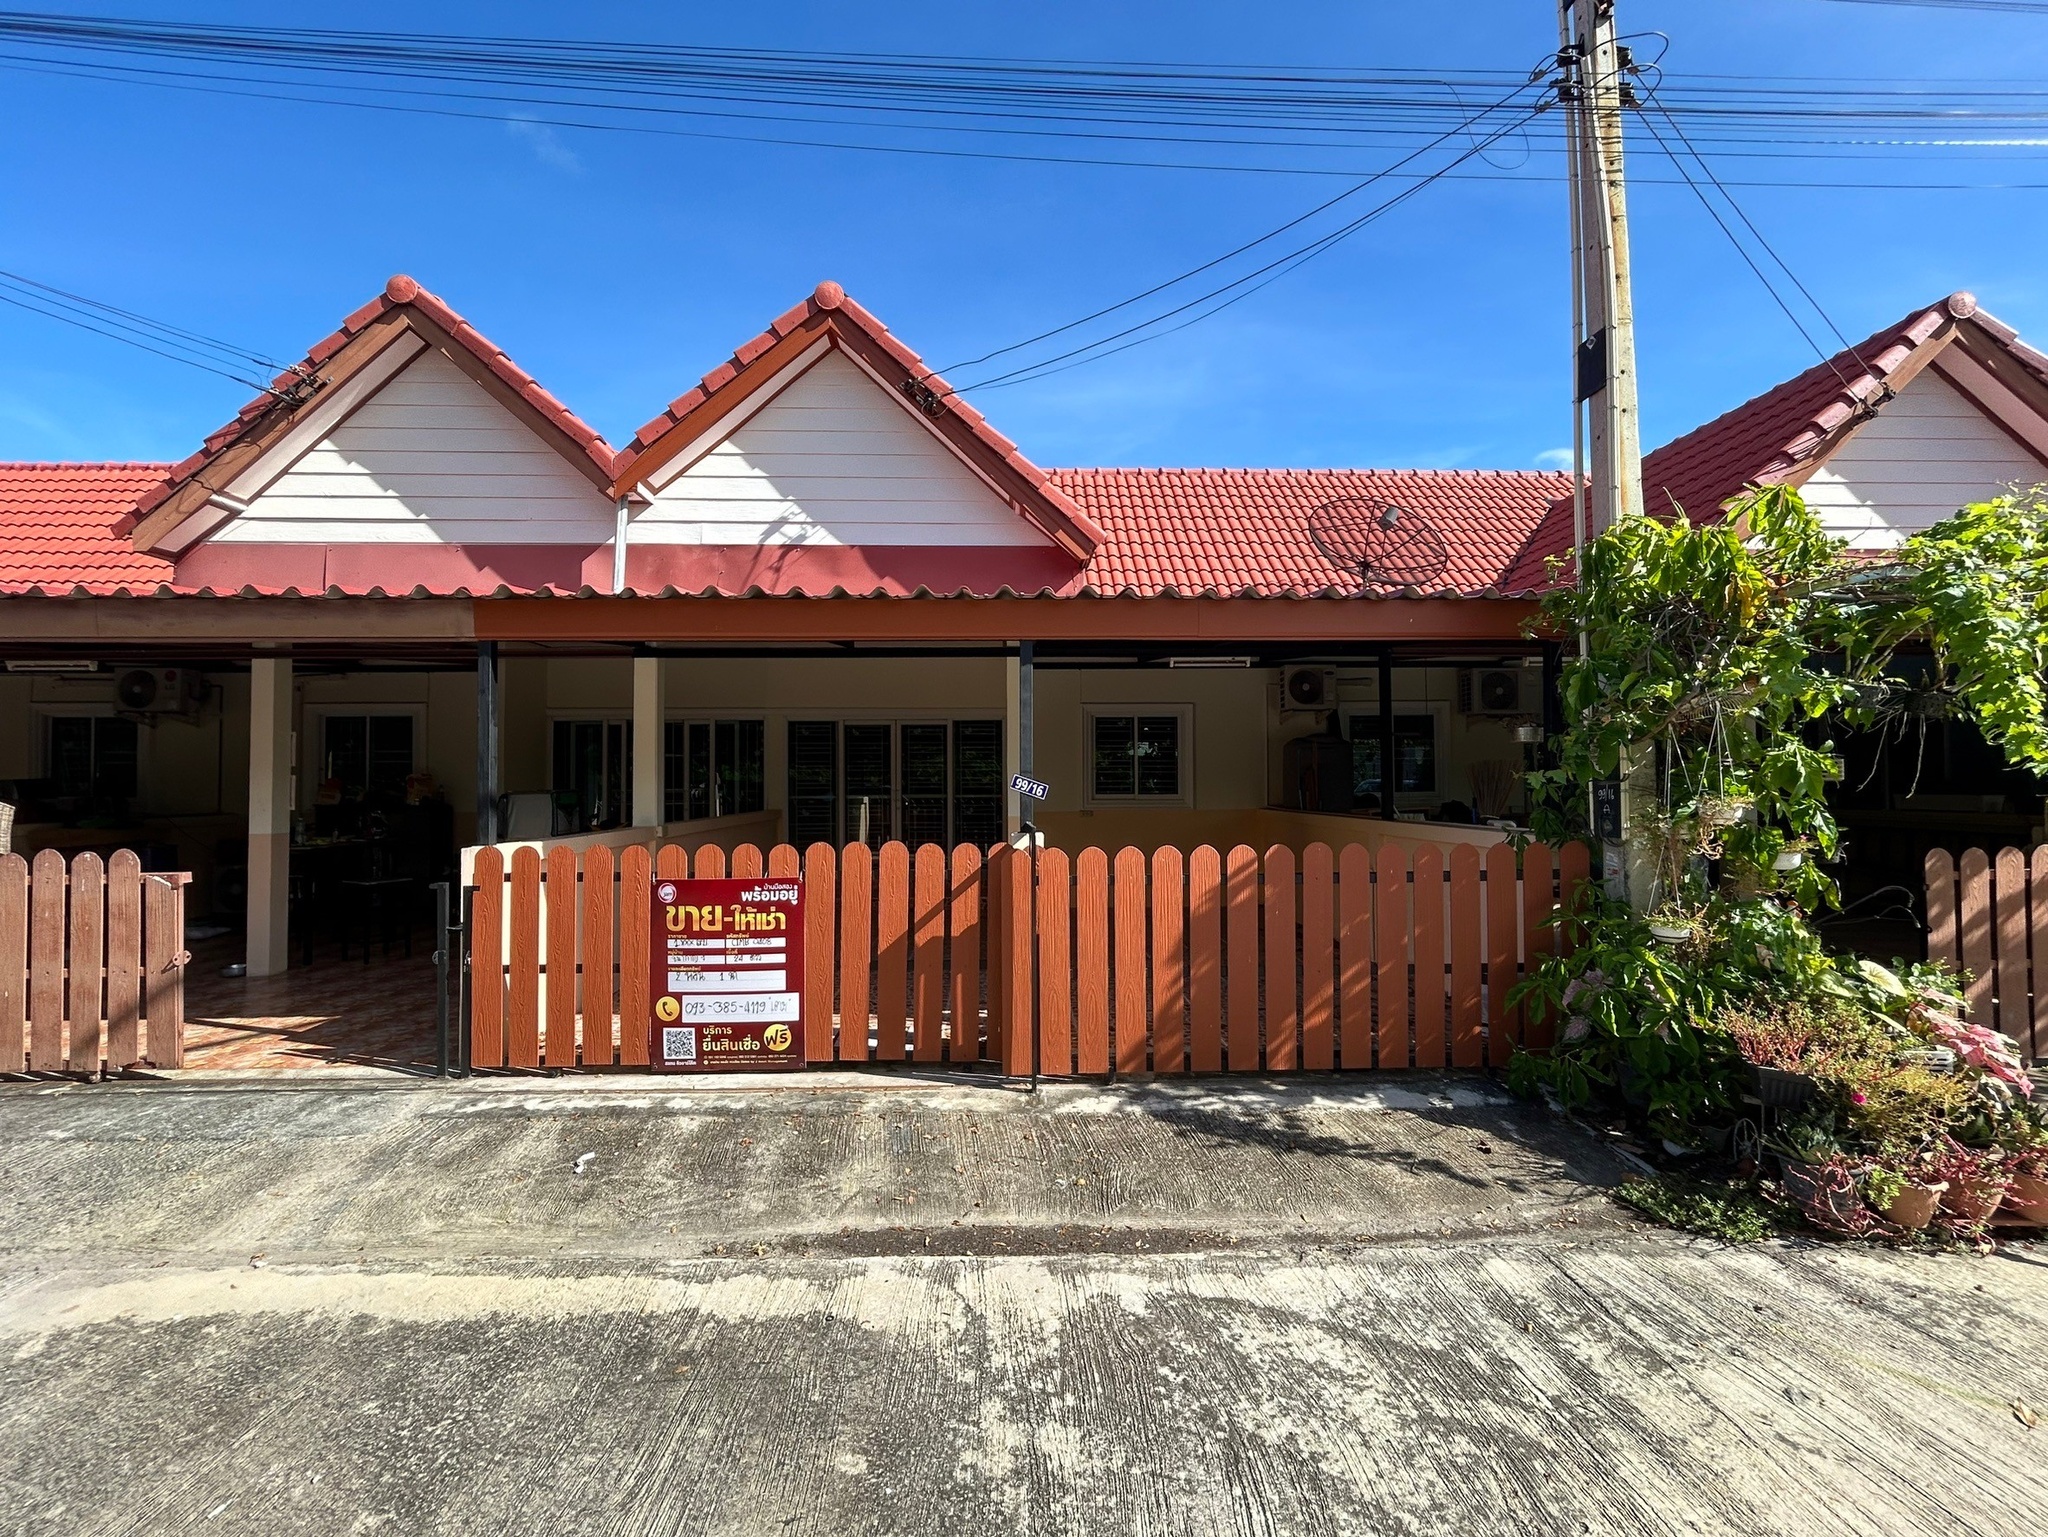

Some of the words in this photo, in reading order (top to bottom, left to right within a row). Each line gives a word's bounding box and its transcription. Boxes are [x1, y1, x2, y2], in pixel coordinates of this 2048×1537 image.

[1014, 778, 1044, 796] 99/16
[741, 885, 798, 905] พร้อมอยู่
[703, 1025, 732, 1035] บริการ
[765, 1028, 789, 1046] ฟรี
[702, 1034, 760, 1051] ยื่นสินเชื่อ
